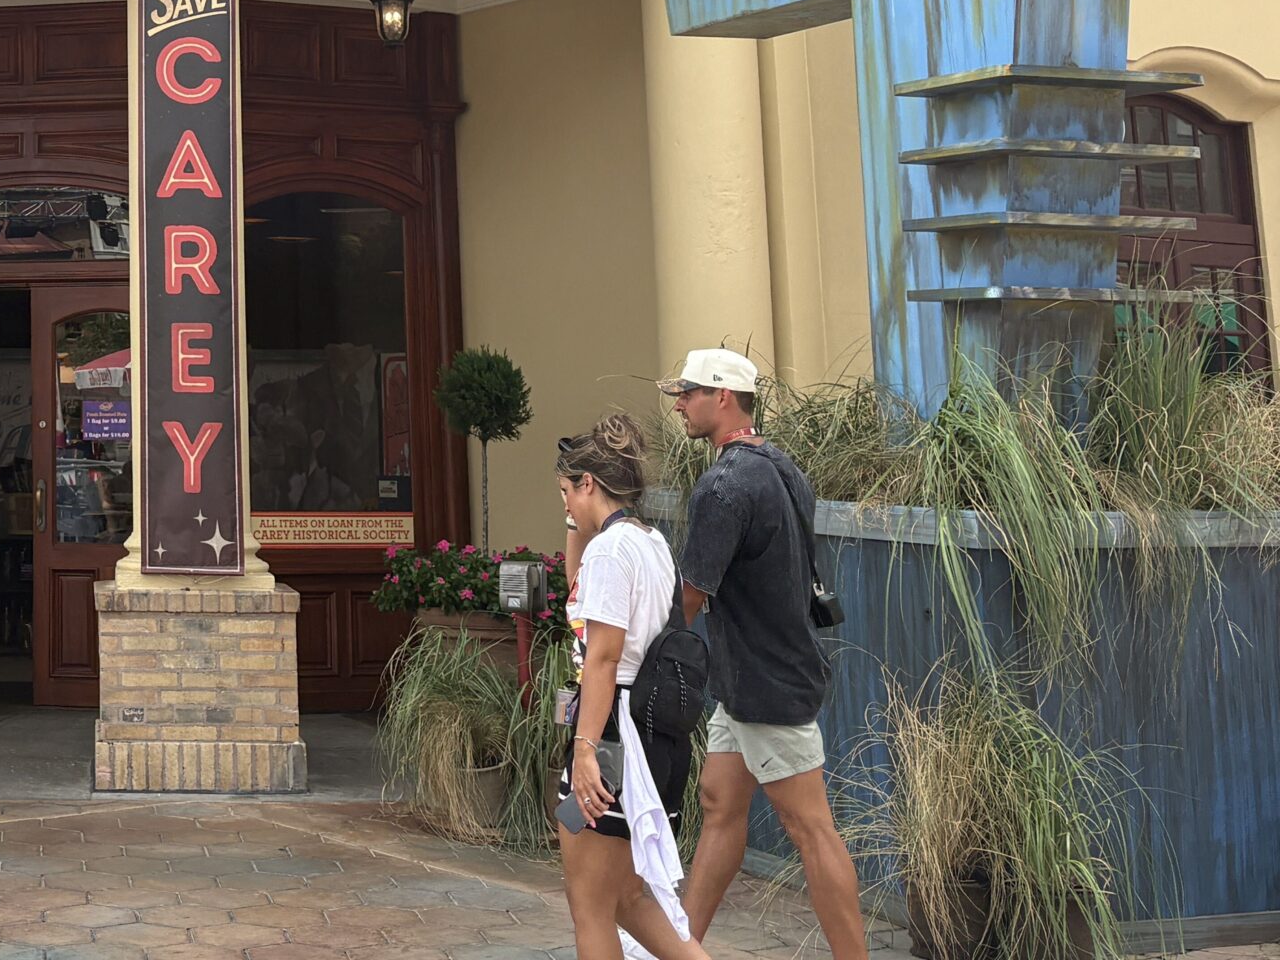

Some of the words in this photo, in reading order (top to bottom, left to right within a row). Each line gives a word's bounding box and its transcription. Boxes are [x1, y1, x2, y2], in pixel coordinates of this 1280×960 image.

[155, 37, 223, 493] CAREY
[259, 519, 278, 528] ALL
[279, 519, 308, 528] ITEMS
[310, 519, 325, 528] ON
[327, 519, 354, 528] LOAN
[355, 519, 383, 528] FROM
[384, 519, 404, 528] THE
[253, 529, 290, 540] CAREY
[293, 529, 360, 540] HISTORICAL
[363, 530, 410, 540] SOCIETY
